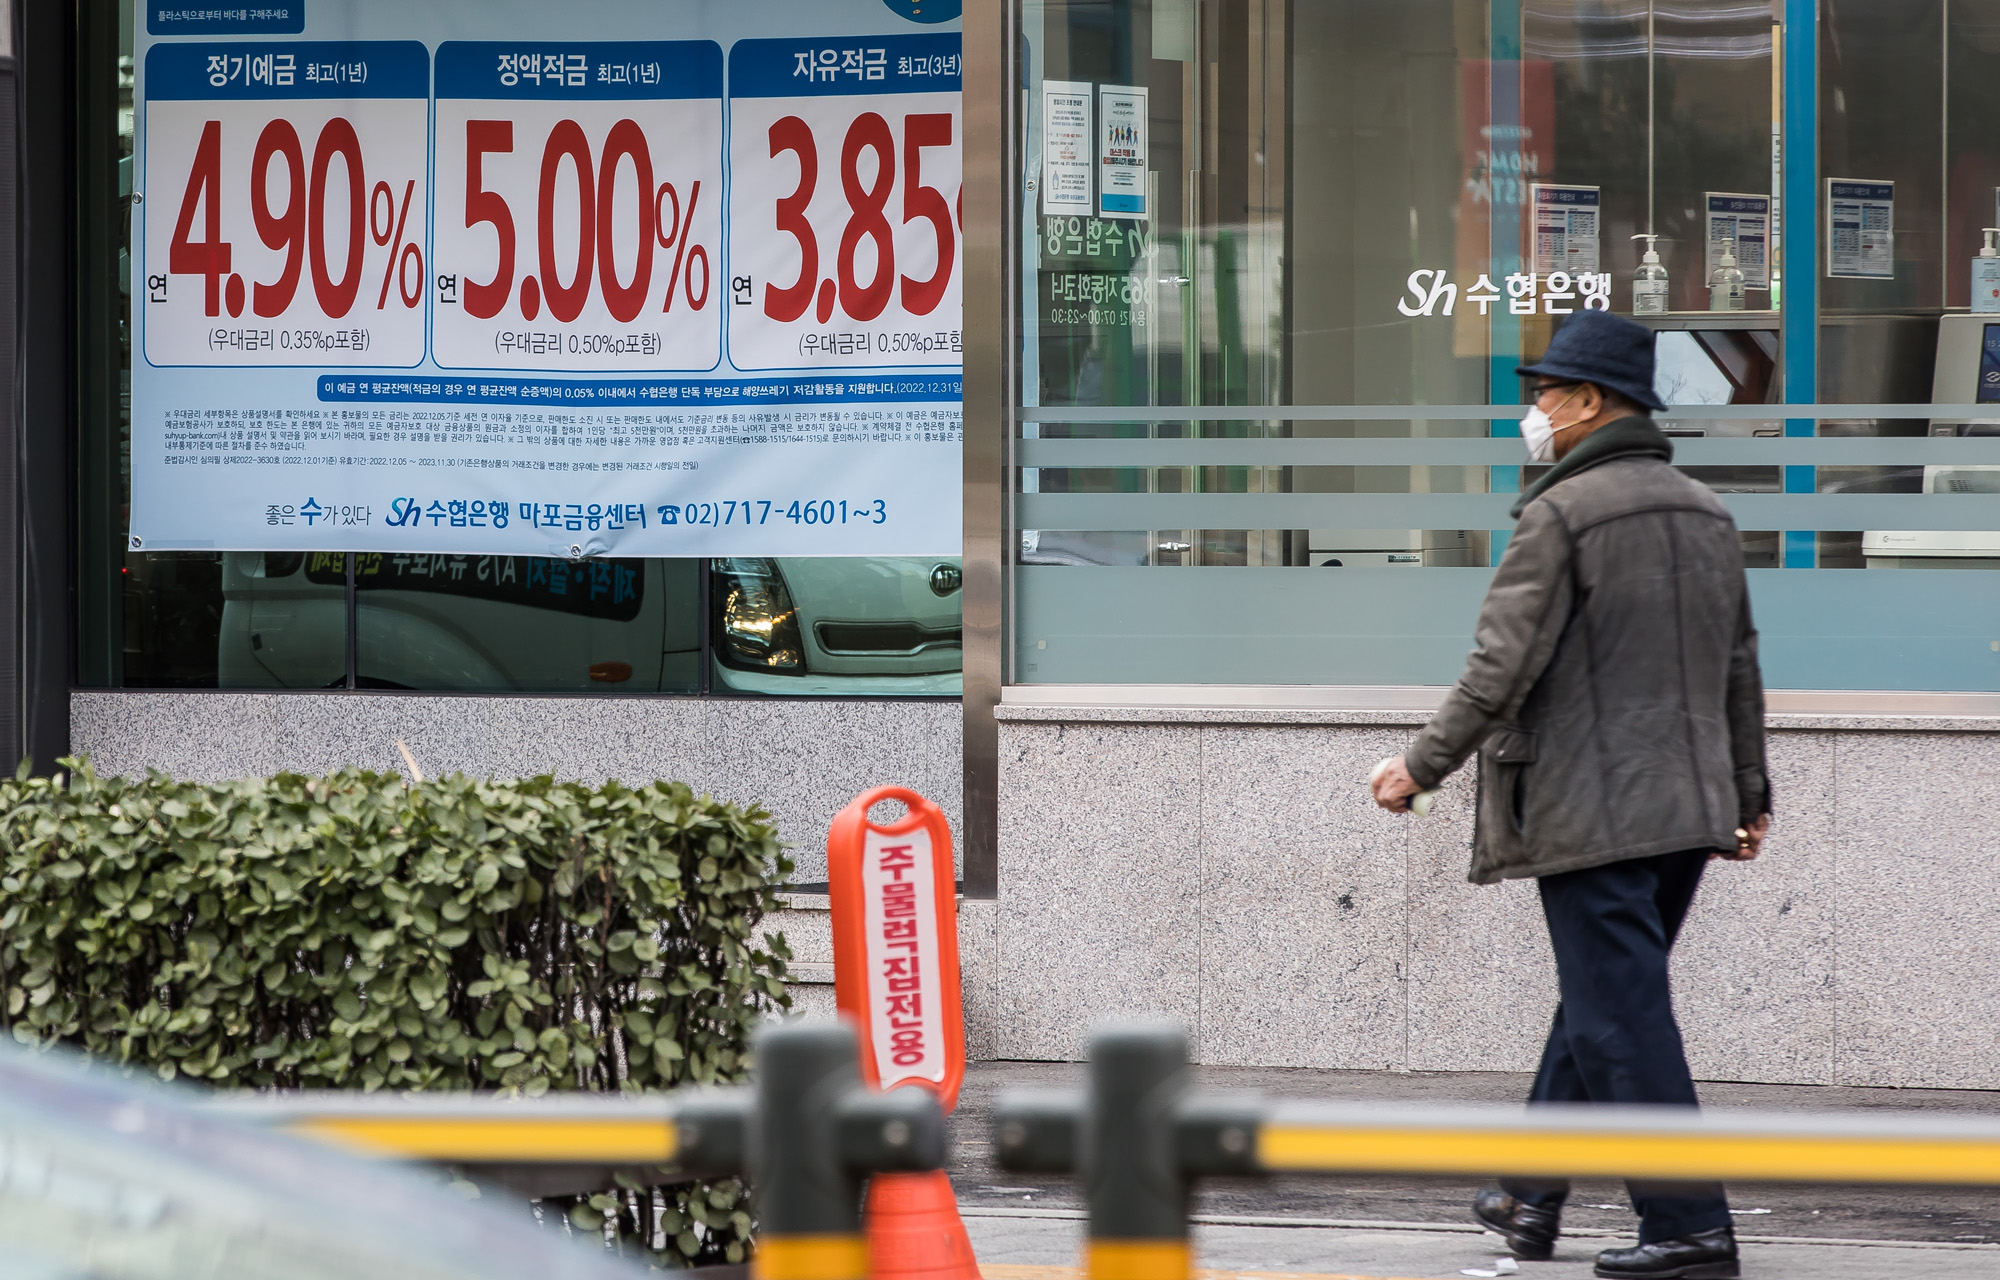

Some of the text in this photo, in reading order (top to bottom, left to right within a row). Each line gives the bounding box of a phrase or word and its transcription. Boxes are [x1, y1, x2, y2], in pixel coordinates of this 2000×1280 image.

[157, 9, 289, 21] 플라스틱으로부터 바다를 구해주세요
[207, 54, 368, 86] 정기예금 최고(1년)
[497, 54, 661, 86] 정액적금 최고(1년)
[793, 48, 962, 83] 자유적금 최고(3년)
[147, 116, 424, 319] 연 4.90%
[437, 118, 710, 323] 연 5.00%
[732, 111, 962, 325] 연 3.85
[1397, 269, 1459, 318] Sh
[1466, 270, 1612, 316] 수협은행
[208, 328, 371, 352] (우대금리 0.35%p포함)
[494, 331, 662, 357] (우대금리 0.50%p포함)
[798, 332, 872, 357] (우대금리
[325, 382, 334, 393] 이
[337, 383, 356, 394] 예금
[359, 383, 368, 394] 연
[445, 384, 463, 395] 경우
[467, 384, 476, 395] 연
[480, 385, 517, 396] 평균잔액
[520, 386, 562, 398] 순증액)의
[565, 388, 595, 398] 0.05%
[598, 387, 636, 398] 이내에서
[639, 386, 678, 398] 수협은행
[681, 387, 700, 398] 단독
[704, 386, 739, 398] 부담으로
[742, 385, 789, 397] 해양쓰레기
[793, 383, 844, 396] 저감활동을
[165, 420, 213, 429] 예금보험공사가
[249, 420, 263, 428] 보호
[266, 421, 287, 430] 한도는
[301, 420, 322, 430] 은행에
[326, 421, 339, 430] 있는
[343, 421, 364, 430] 귀하의
[368, 421, 382, 430] 모든
[386, 421, 421, 431] 예금자보호
[426, 422, 440, 432] 대상
[444, 422, 480, 432] 금융상품의
[485, 423, 507, 433] 원금과
[510, 424, 531, 434] 소정의
[535, 425, 557, 435] 이자를
[562, 426, 583, 435] 합하여
[587, 426, 606, 436] 1인당
[678, 425, 707, 435] 5천만원을
[710, 425, 738, 434] 초과하는
[742, 424, 766, 433] 나머지
[770, 423, 793, 433] 금액은
[797, 423, 825, 432] 보호하지
[828, 422, 860, 432] 않습니다.
[872, 422, 901, 432] 계약체결
[916, 421, 944, 431] 수협은행
[173, 410, 201, 419] 우대금리
[203, 409, 238, 419] 세부항목은
[241, 409, 282, 419] 상품설명서를
[286, 410, 320, 419] 확인하세요
[341, 410, 369, 420] 홍보물의
[372, 411, 386, 420] 모든
[389, 411, 409, 421] 금리는
[463, 412, 478, 422] 세전
[491, 413, 512, 422] 이자율
[548, 415, 576, 425] 판매한도
[579, 415, 593, 425] 소진
[606, 415, 621, 425] 또는
[624, 415, 652, 425] 판매한도
[655, 415, 684, 424] 내에서도
[687, 415, 714, 424] 기준금리
[731, 413, 745, 423] 등의
[748, 413, 780, 423] 사유발생
[794, 412, 817, 422] 금리가
[820, 412, 840, 421] 변동될
[853, 411, 884, 421] 있습니다.
[906, 410, 927, 420] 예금은
[165, 441, 308, 451] 내부통제기준에 따른 절차를 준수 하였습니다.
[230, 431, 243, 440] 상품
[247, 431, 267, 440] 설명서
[279, 431, 300, 440] 약관을
[303, 431, 317, 440] 읽어
[320, 431, 341, 440] 보시기
[369, 432, 390, 441] 필요한
[393, 432, 407, 442] 경우
[410, 432, 430, 442] 설명을
[433, 432, 447, 442] 받을
[451, 433, 472, 442] 권리가
[475, 434, 506, 443] 있습니다.
[526, 436, 540, 445] 밖의
[543, 436, 565, 446] 상품에
[568, 437, 582, 446] 대한
[585, 437, 607, 446] 자세한
[610, 436, 631, 446] 내용은
[634, 436, 656, 446] 가까운
[659, 436, 680, 446] 영업점
[682, 436, 695, 445] 혹은
[832, 433, 869, 443] 문의하시기
[872, 433, 904, 442] 바랍니다.
[924, 432, 954, 442] 홍보물은
[164, 455, 198, 464] 준법감시인
[200, 456, 220, 465] 심의필
[223, 456, 280, 465] 상제2022-3630호
[282, 456, 337, 465] (2022.12.01기준)
[418, 458, 456, 467] 2023.11.30
[457, 458, 509, 469] (기존은행상품의
[512, 460, 545, 470] 거래조건을
[548, 461, 569, 471] 변경한
[572, 462, 599, 472] 경우에는
[602, 462, 623, 471] 변경된
[626, 462, 652, 471] 거래조건
[654, 461, 680, 470] 시행일의
[682, 461, 699, 470] 전일)
[264, 496, 372, 526] 좋은 수가 있다
[385, 496, 887, 533] Sh 수협은행 마포금융센터 02)717-4601~3
[879, 844, 926, 1067] 주물럭집전용
